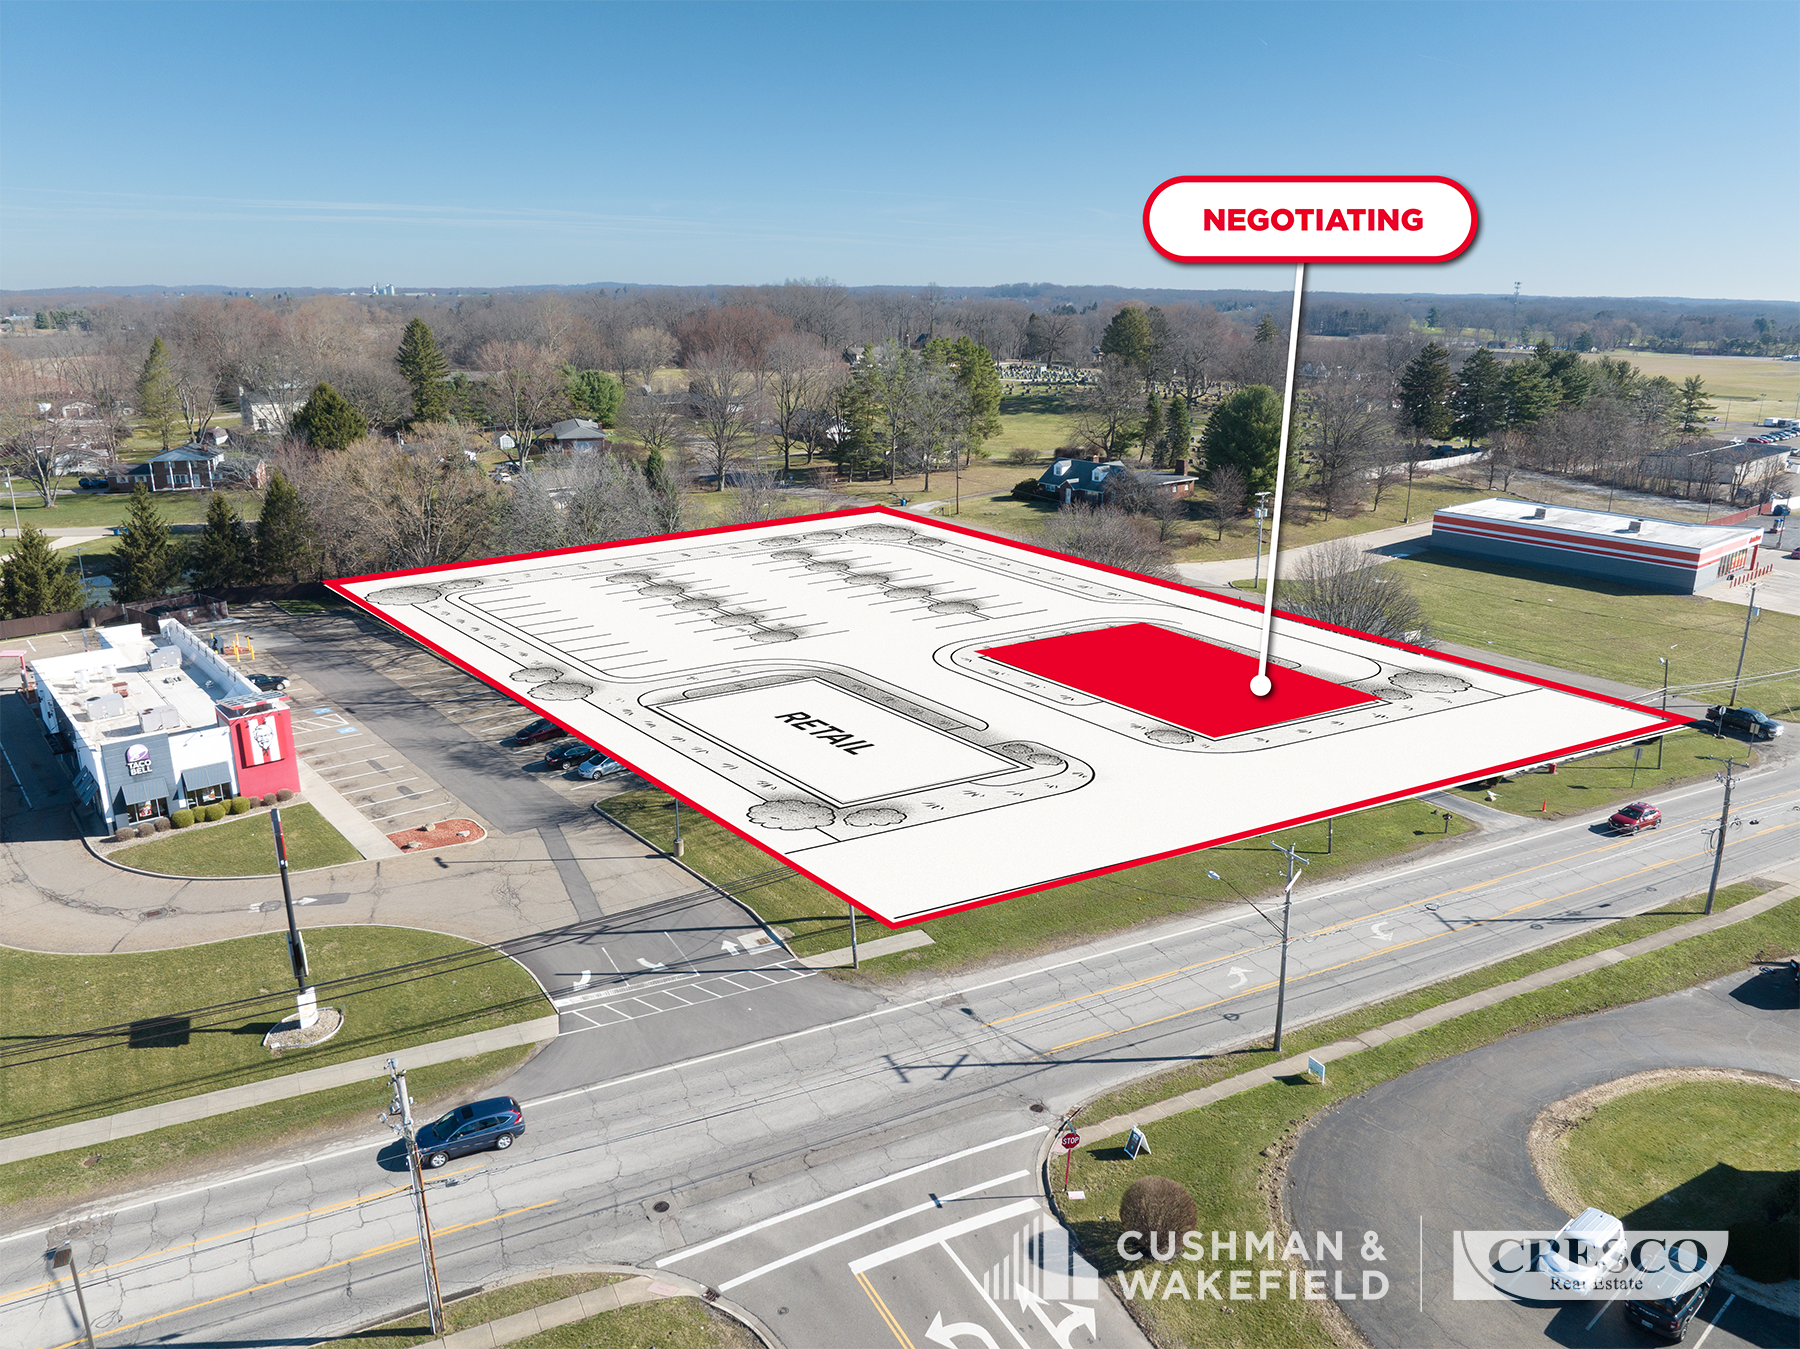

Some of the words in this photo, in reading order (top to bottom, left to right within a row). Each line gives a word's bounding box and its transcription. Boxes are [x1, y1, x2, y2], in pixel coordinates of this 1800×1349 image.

[128, 759, 151, 769] TACO
[130, 765, 153, 776] BELL
[1062, 1136, 1080, 1145] STOP
